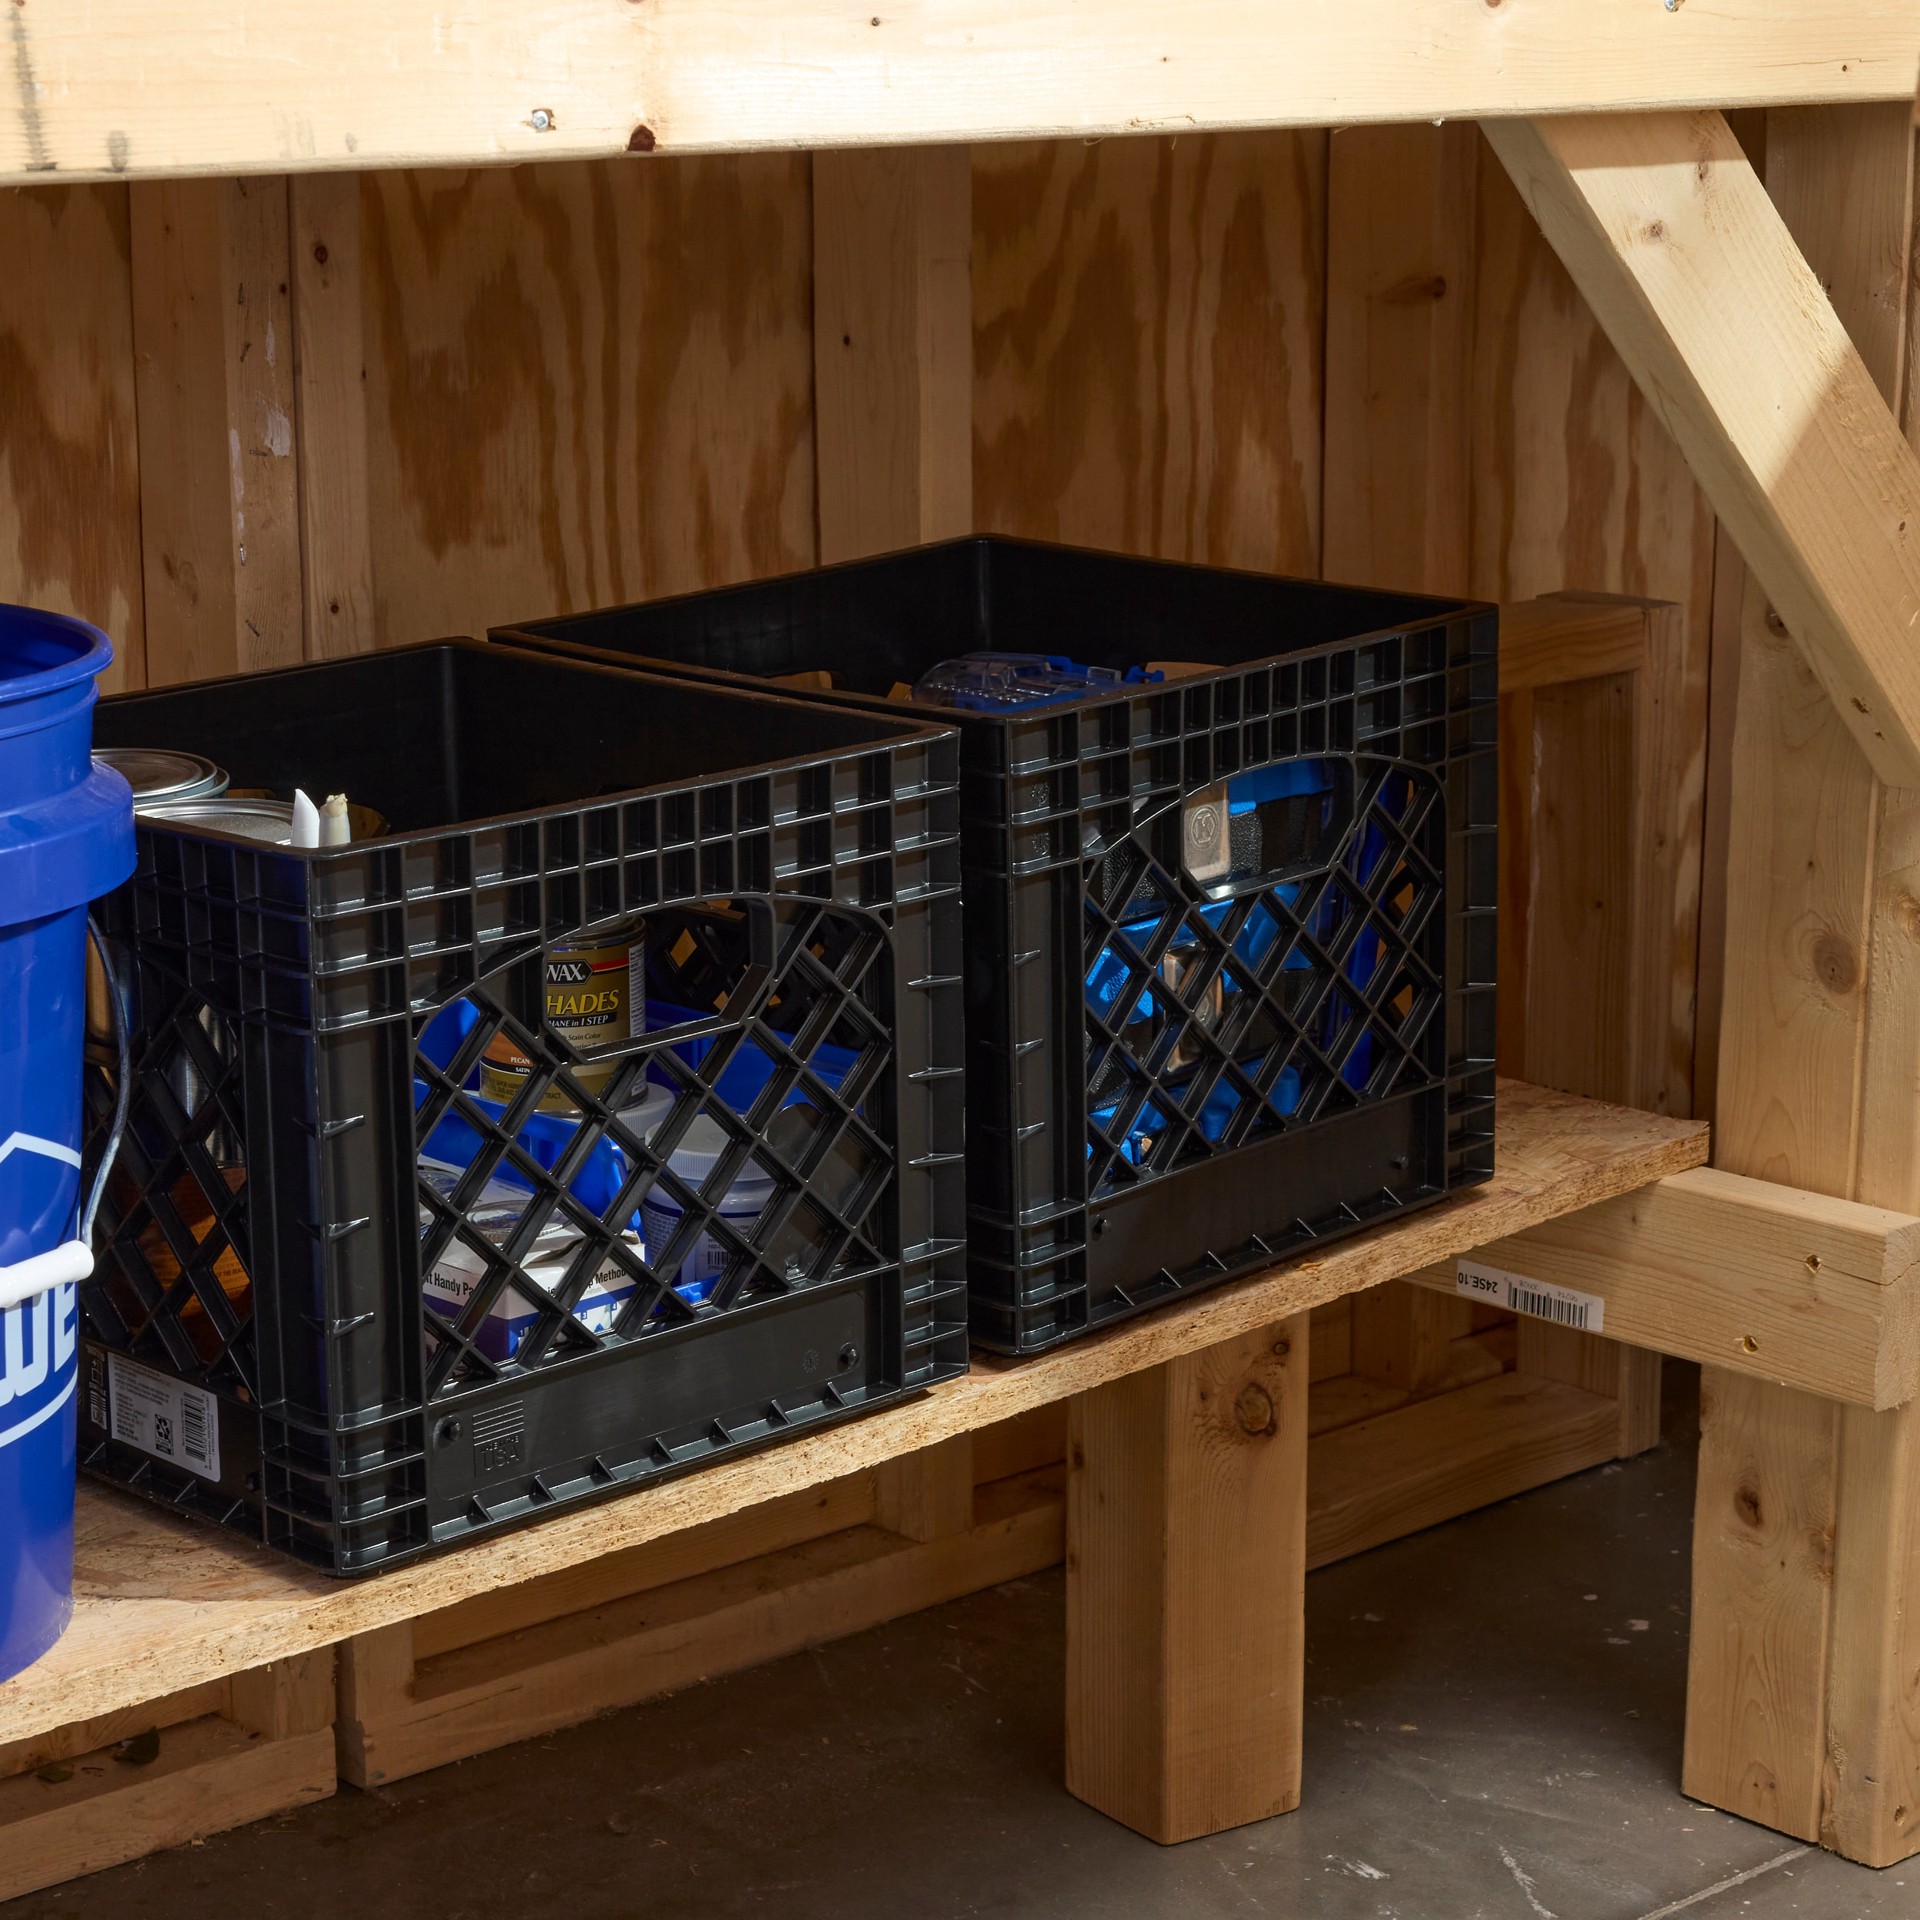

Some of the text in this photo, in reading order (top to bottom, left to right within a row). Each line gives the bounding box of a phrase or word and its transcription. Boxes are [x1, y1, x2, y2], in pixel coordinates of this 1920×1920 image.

[547, 989, 619, 1015] HADES
[586, 1015, 609, 1026] STEP
[568, 1033, 584, 1041] Stain
[584, 1031, 602, 1040] Color
[510, 1056, 531, 1065] PECAN
[515, 1066, 531, 1074] SATIN
[434, 1273, 460, 1296] Handy
[1458, 1272, 1498, 1293] 24SE.10
[481, 1444, 520, 1471] USA
